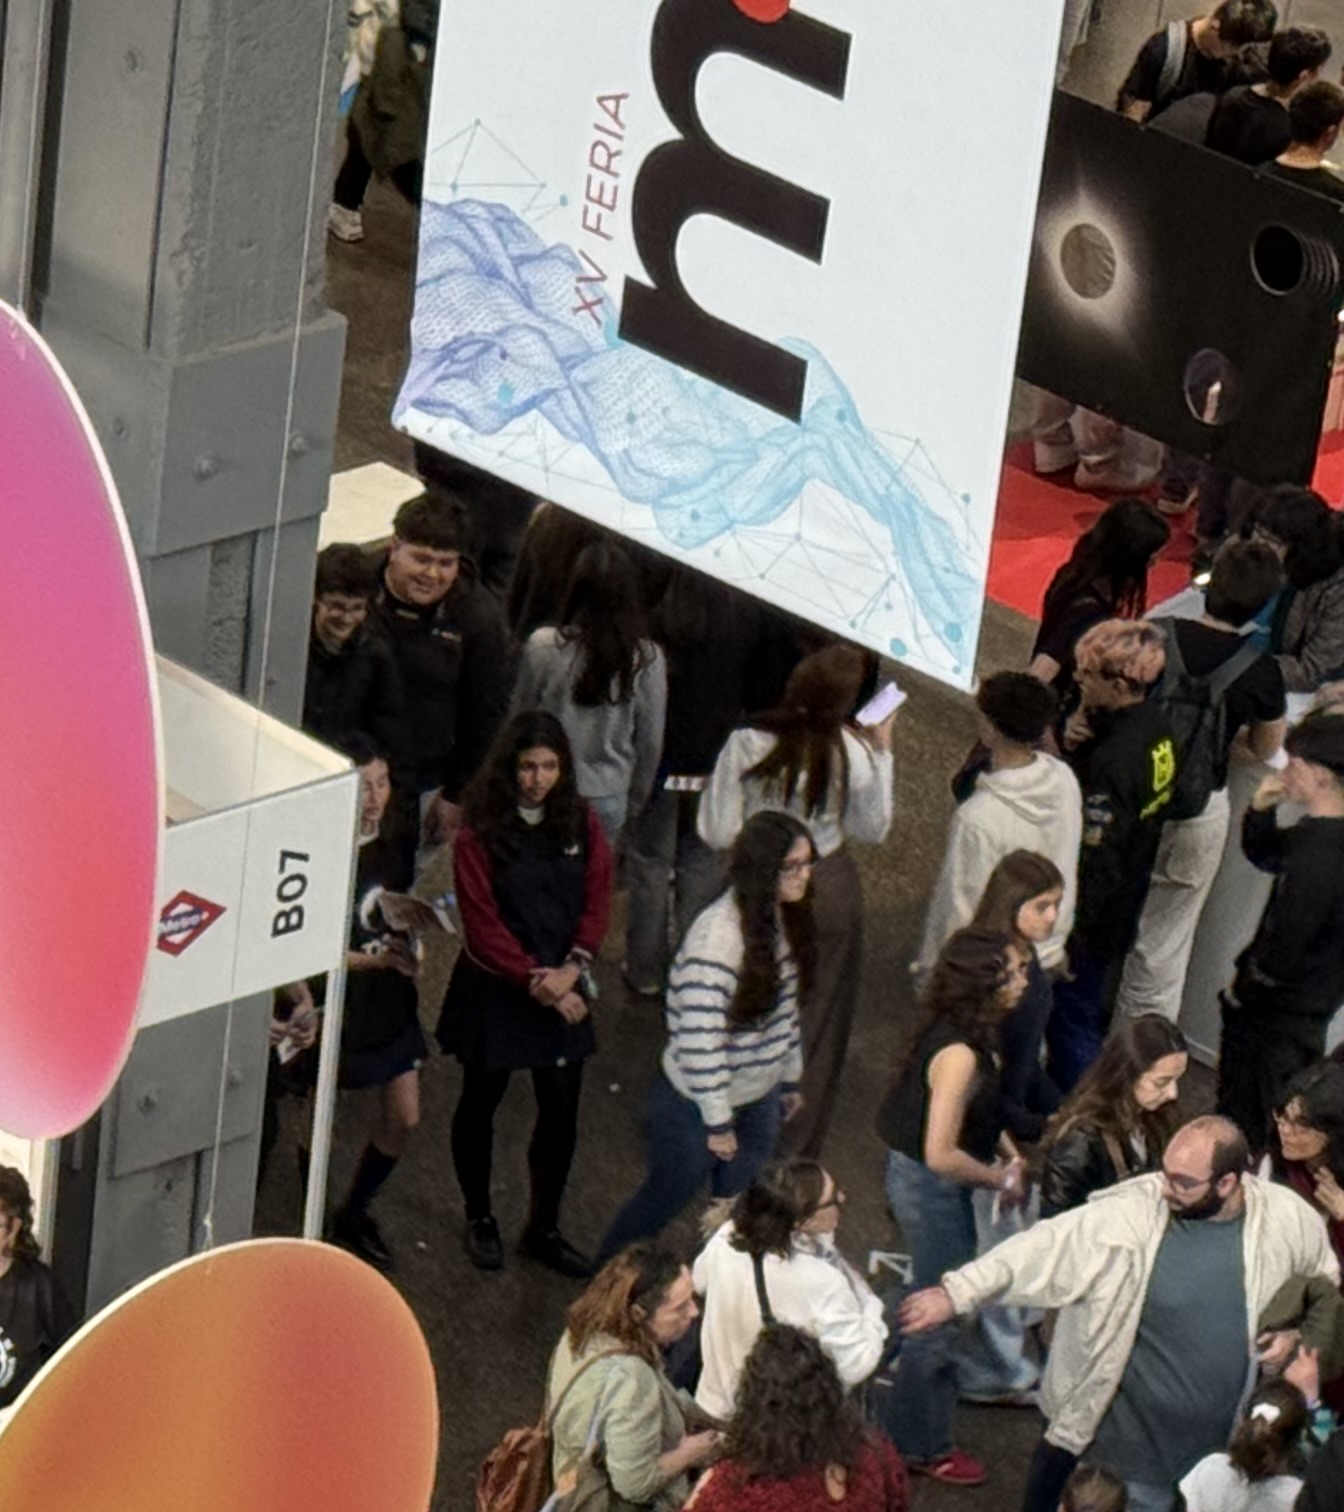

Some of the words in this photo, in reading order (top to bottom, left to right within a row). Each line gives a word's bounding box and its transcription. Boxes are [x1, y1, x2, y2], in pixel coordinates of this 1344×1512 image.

[581, 91, 630, 242] FERIA
[571, 249, 607, 327] XV
[270, 848, 311, 939] B07
